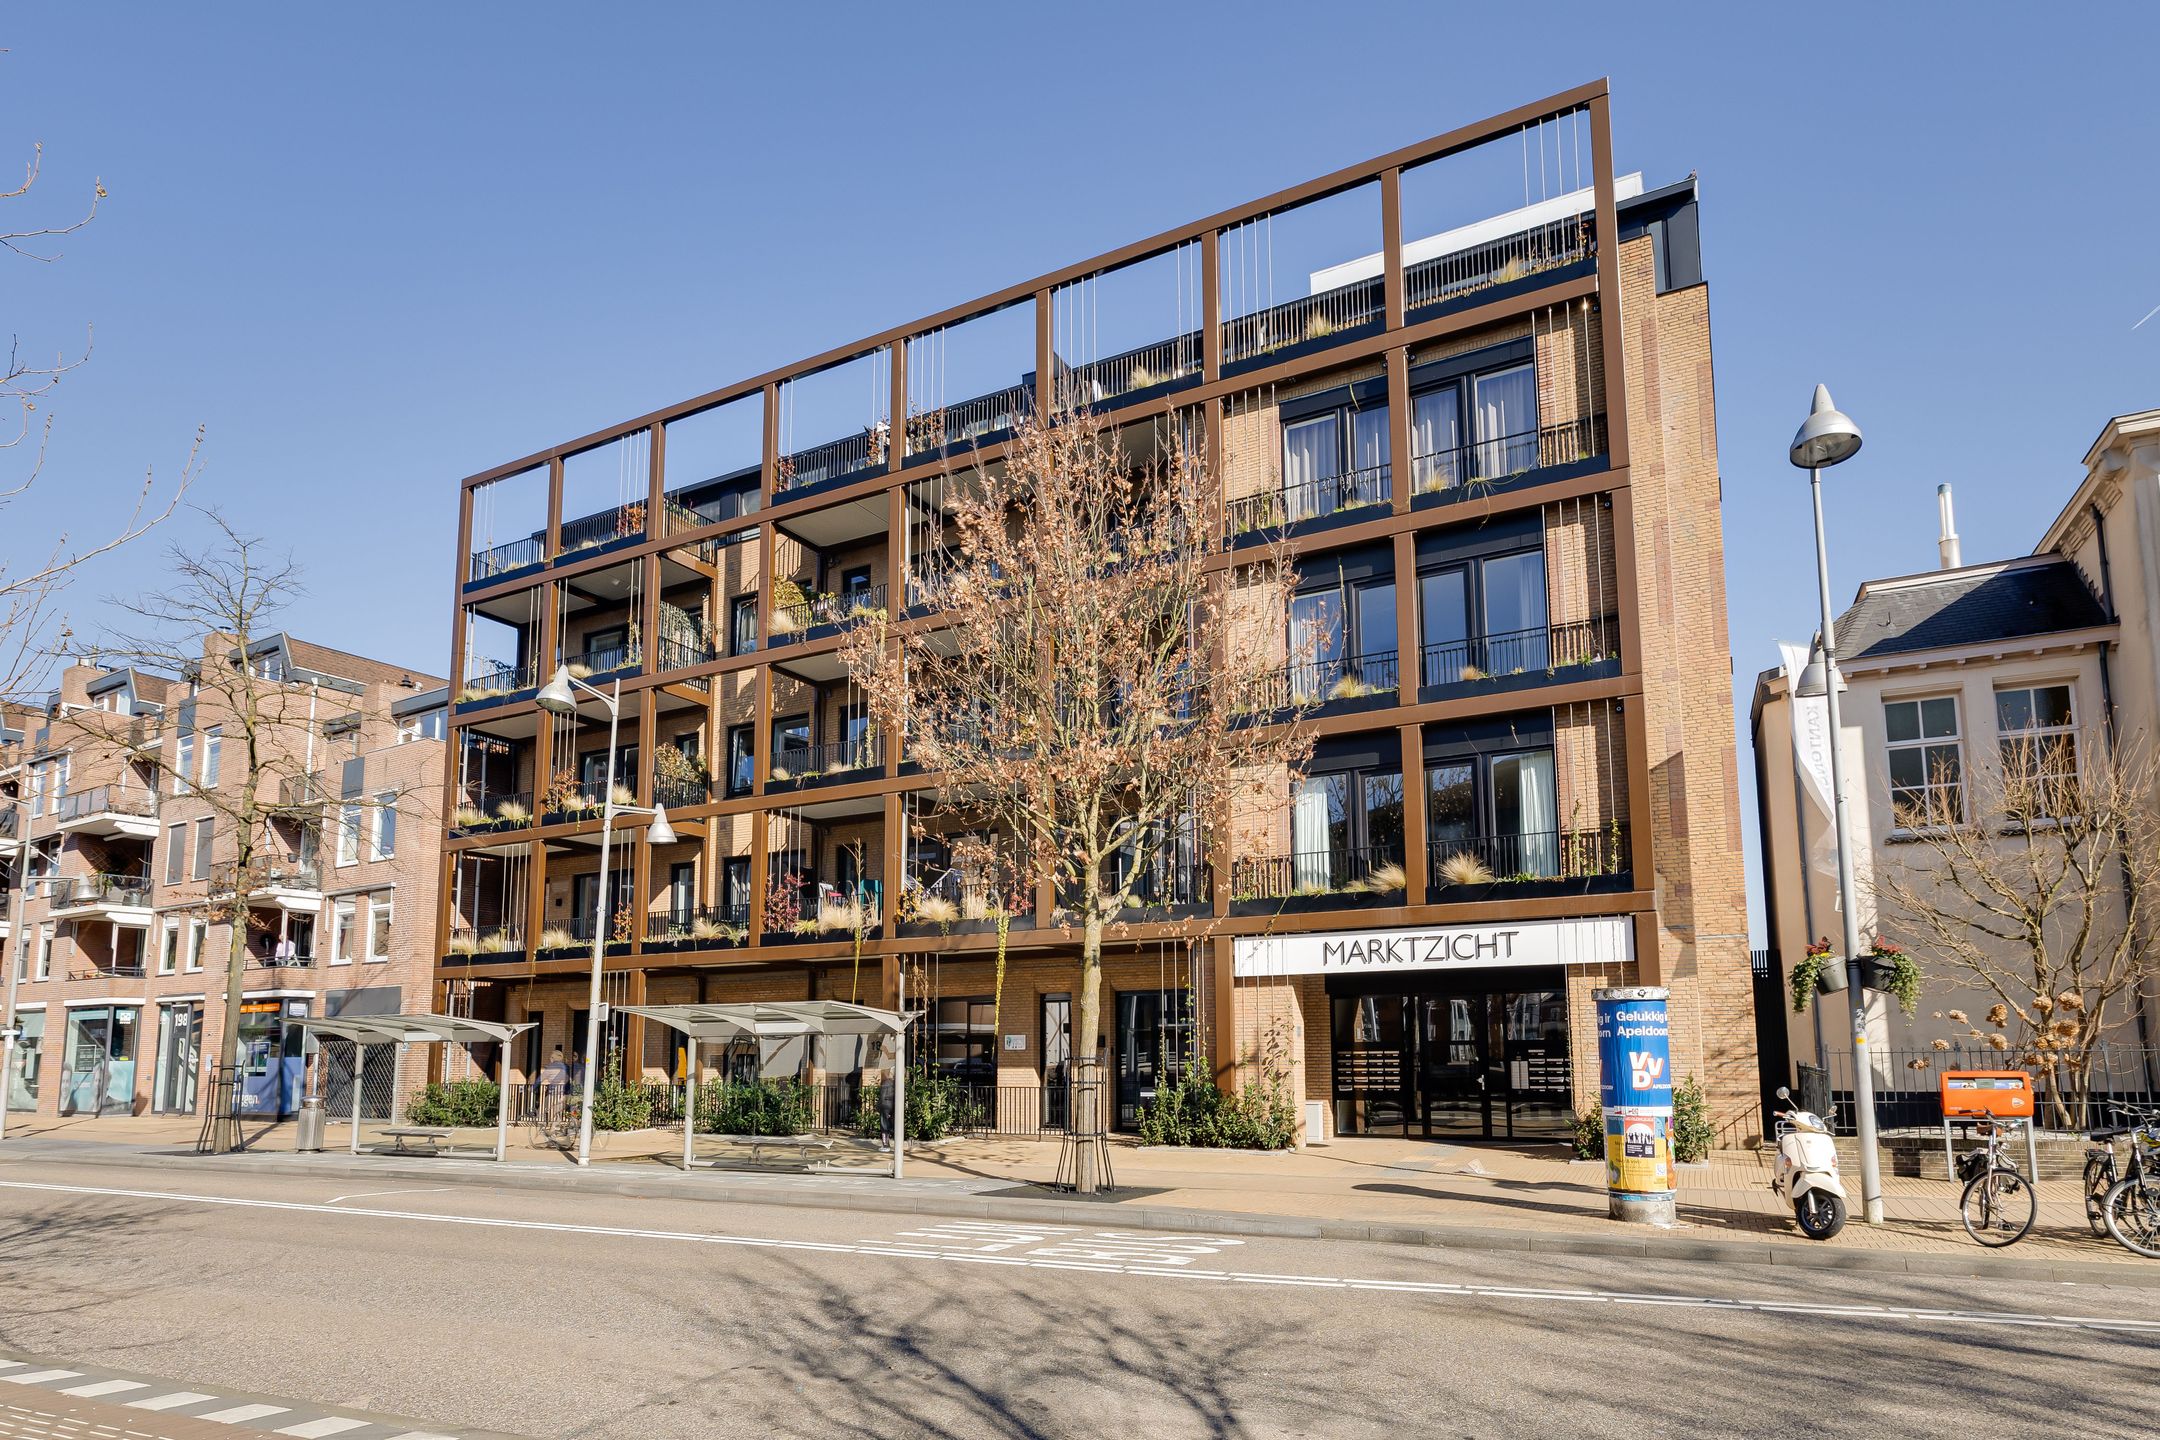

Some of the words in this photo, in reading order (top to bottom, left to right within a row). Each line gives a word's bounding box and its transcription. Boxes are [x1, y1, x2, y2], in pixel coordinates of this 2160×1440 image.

[1323, 931, 1519, 966] MARKTZICHT
[174, 1013, 187, 1026] 198
[1616, 1011, 1664, 1024] Gelukkig
